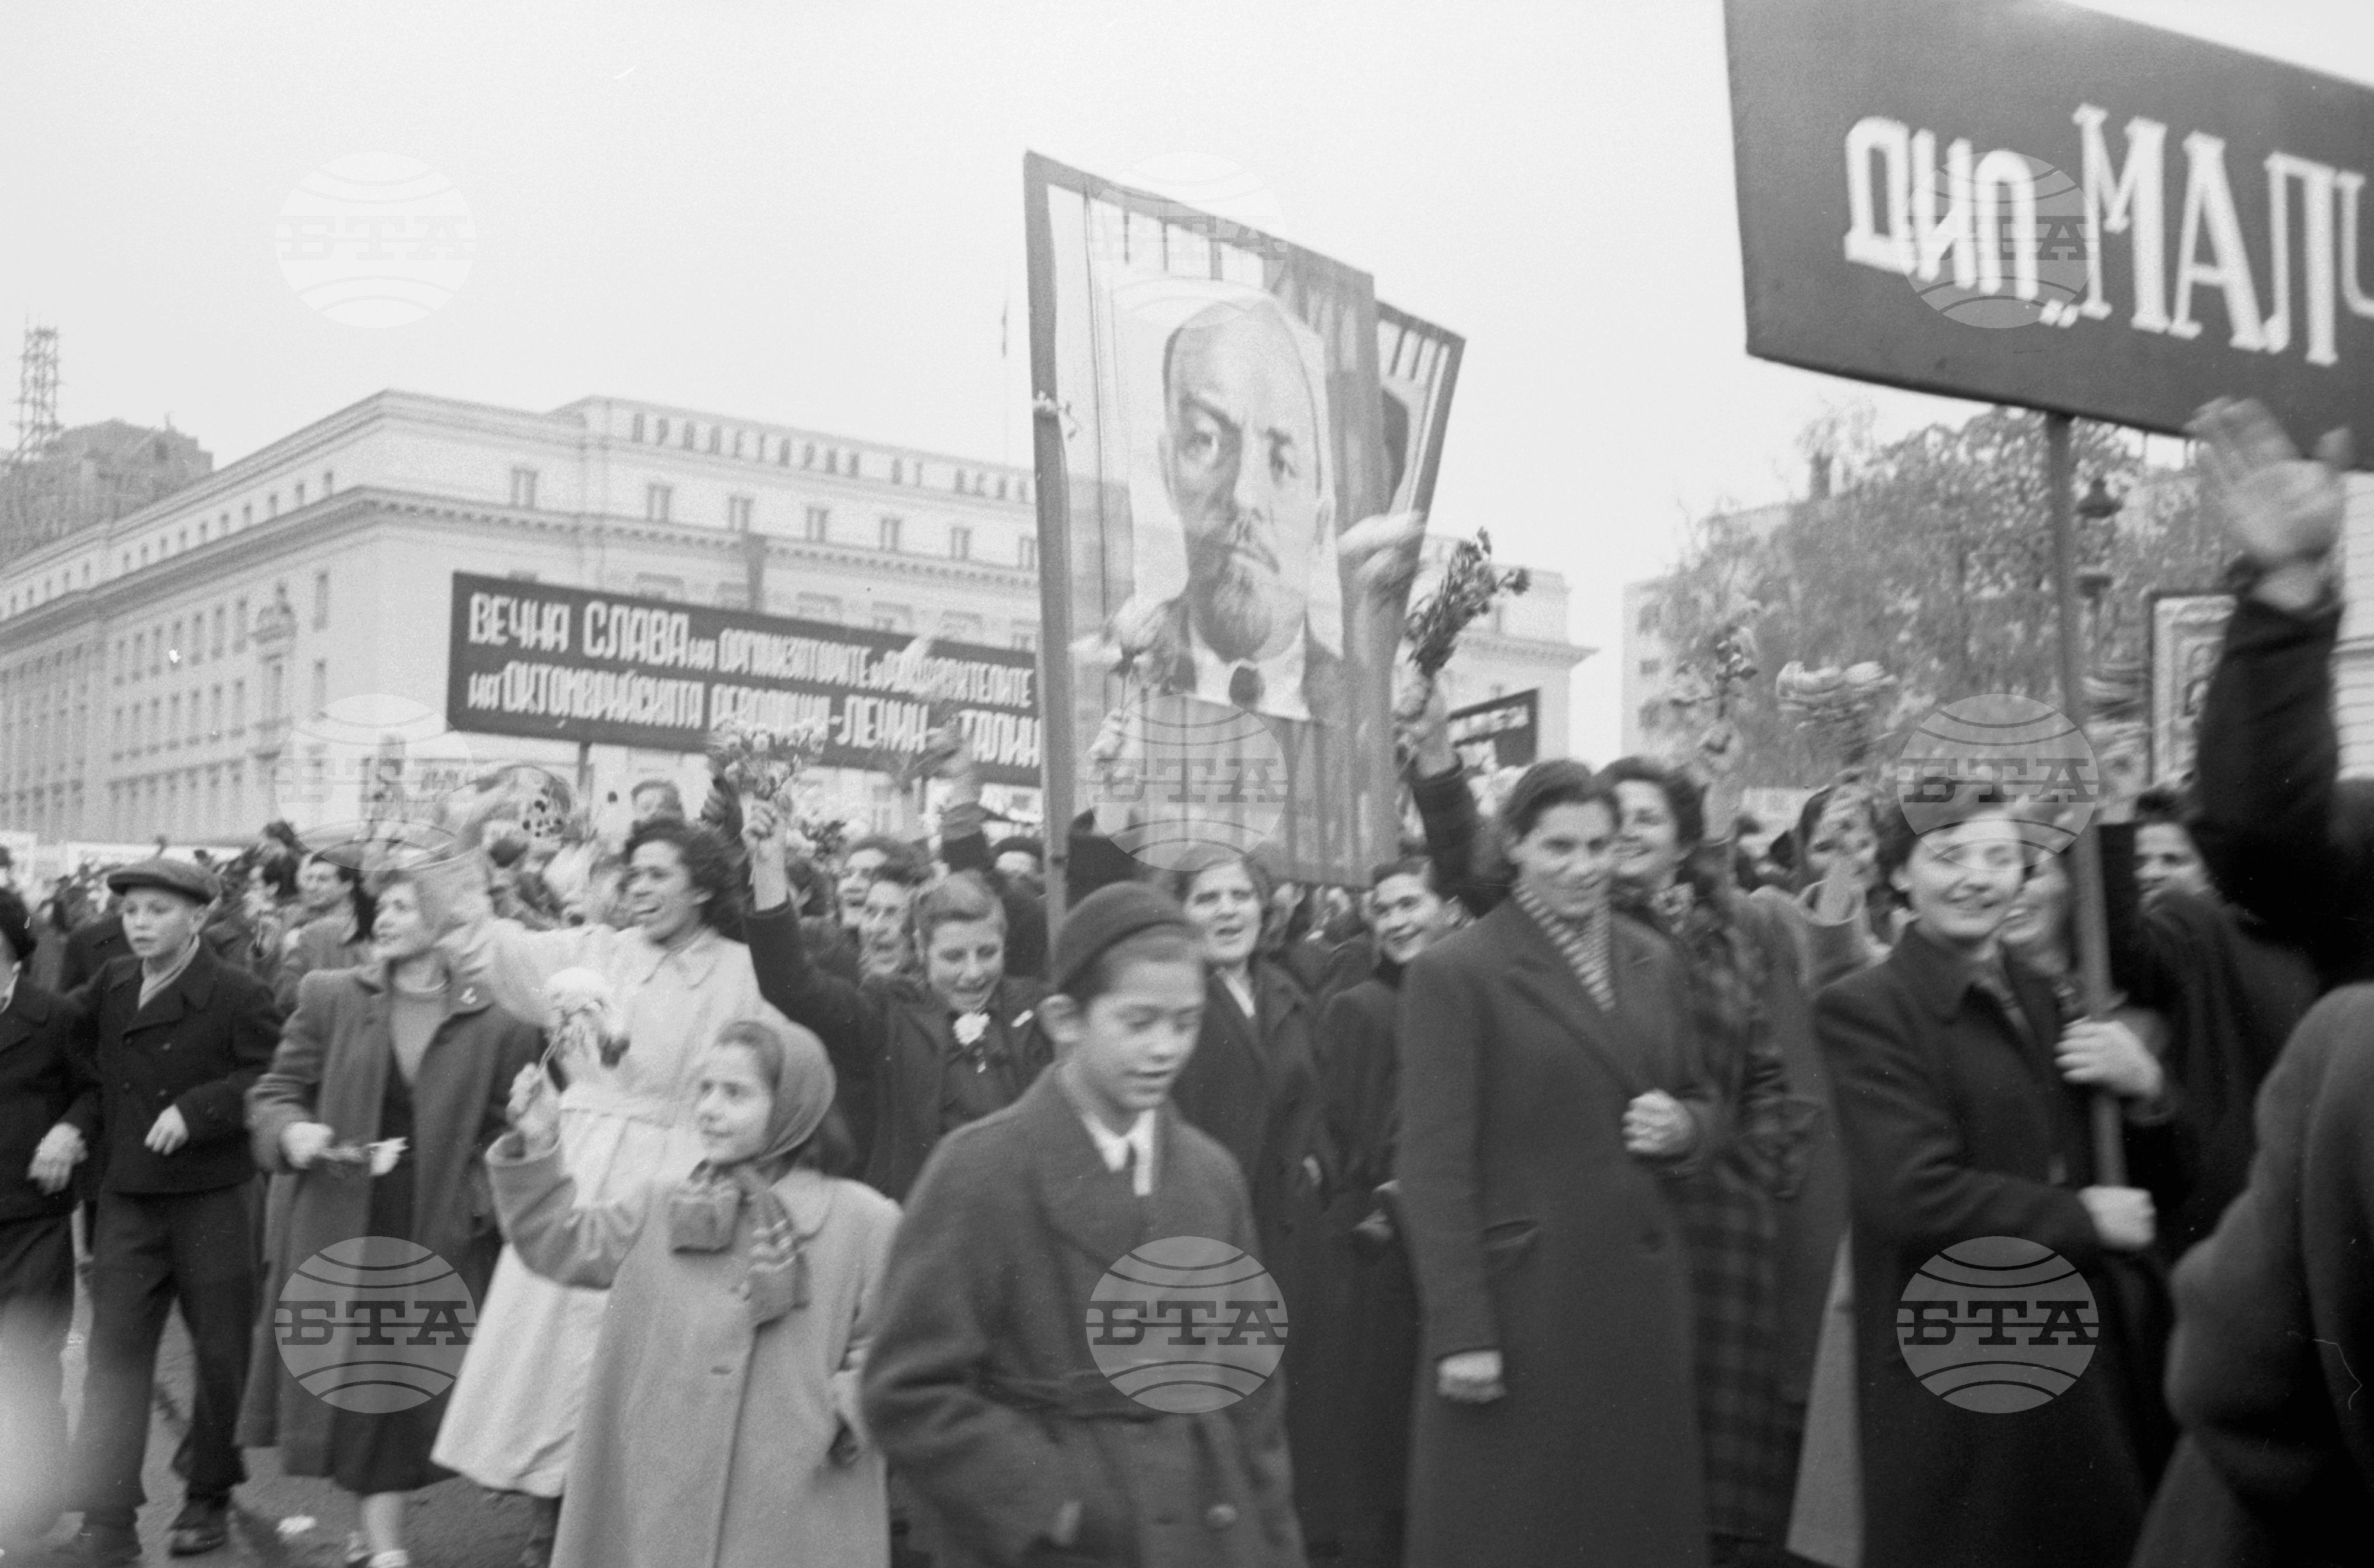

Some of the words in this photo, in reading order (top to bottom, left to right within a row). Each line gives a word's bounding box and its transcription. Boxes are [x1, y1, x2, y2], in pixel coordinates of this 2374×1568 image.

[1844, 116, 2037, 300] ДИП
[469, 592, 570, 653] ВЕЧНА
[583, 599, 690, 667] СЛАВА
[502, 661, 704, 729] ОКТОМВРИЙСКАТА
[951, 709, 1041, 768] ТАЛИН
